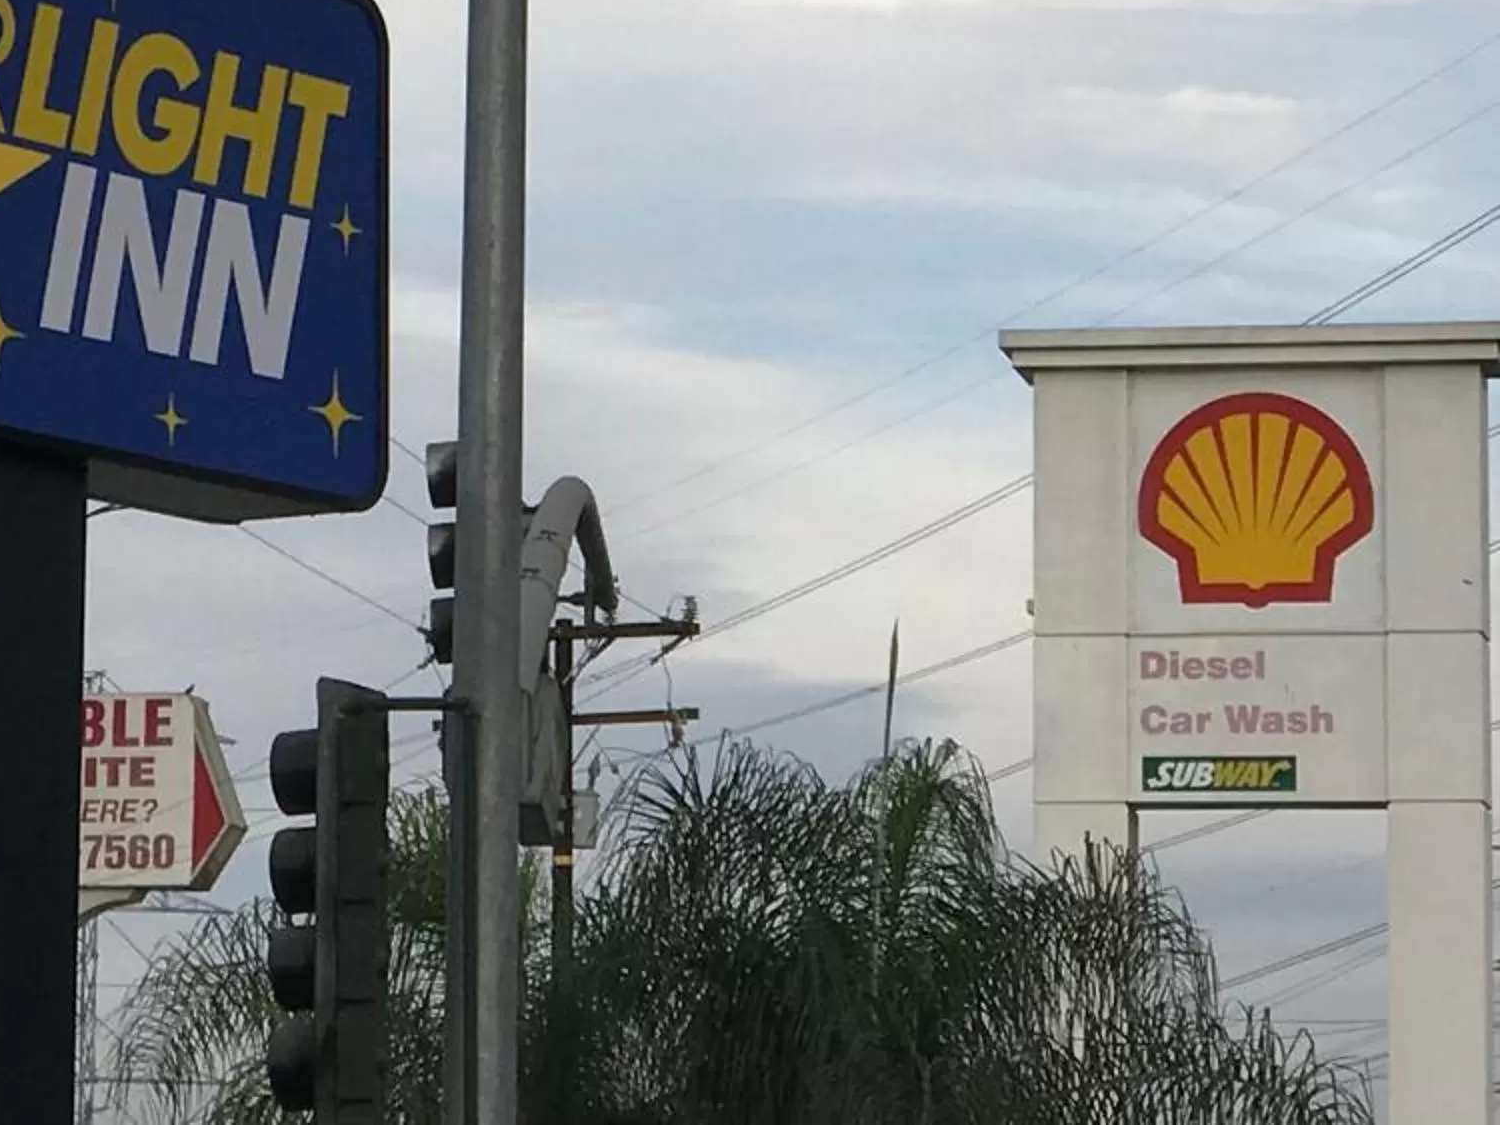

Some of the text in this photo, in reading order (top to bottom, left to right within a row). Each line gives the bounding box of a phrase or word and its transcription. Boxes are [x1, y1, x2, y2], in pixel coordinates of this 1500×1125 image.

[39, 159, 311, 380] INN
[1139, 650, 1266, 680] Diesel
[1139, 704, 1335, 735] Car Wash
[84, 756, 156, 788] ITE
[1147, 760, 1293, 788] SUBWAY
[83, 834, 175, 870] 7560
